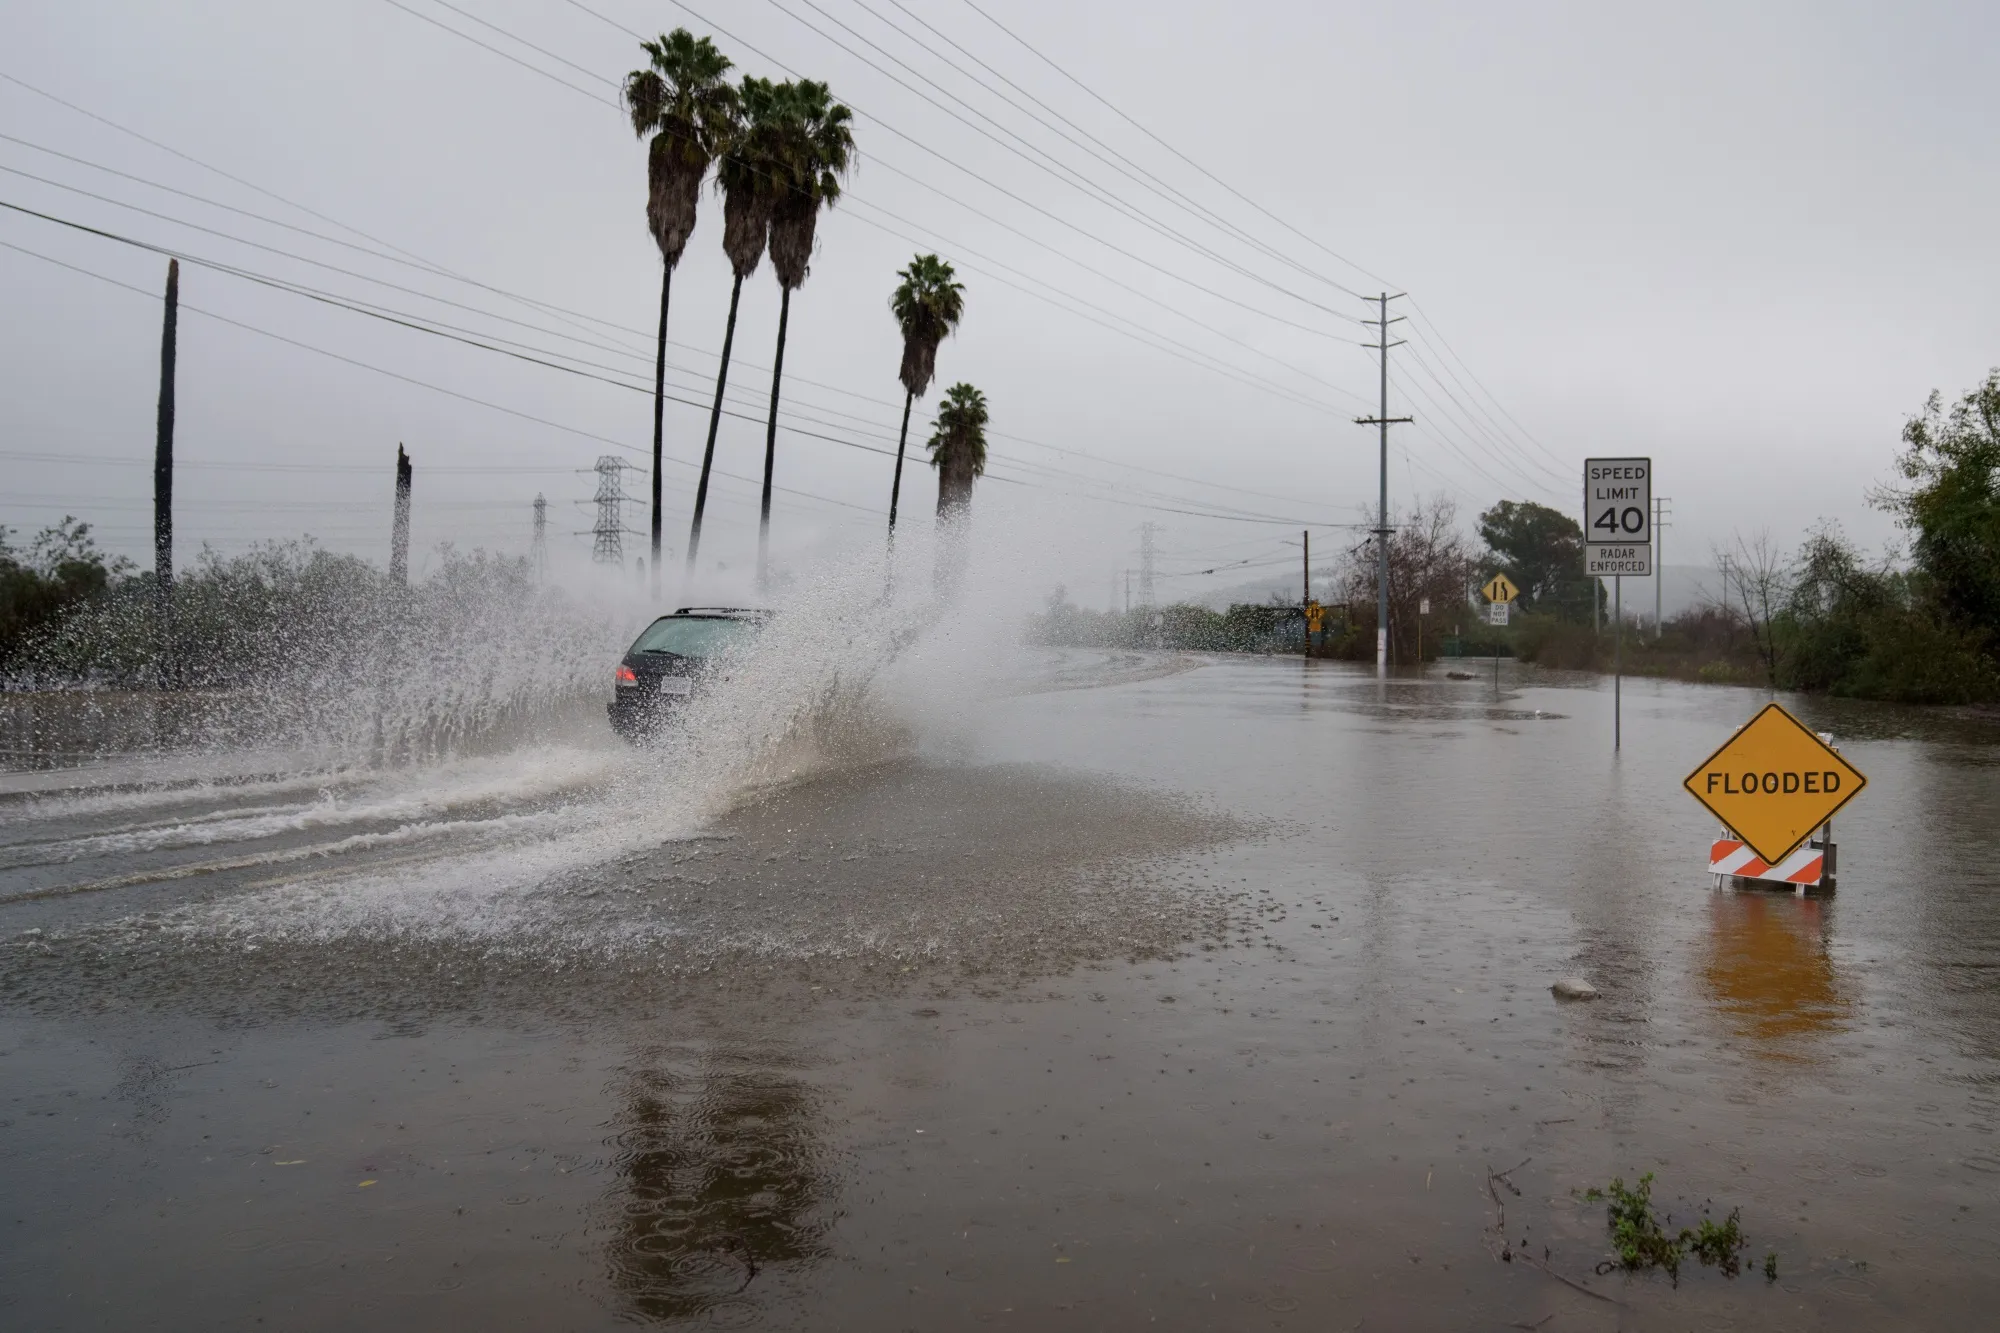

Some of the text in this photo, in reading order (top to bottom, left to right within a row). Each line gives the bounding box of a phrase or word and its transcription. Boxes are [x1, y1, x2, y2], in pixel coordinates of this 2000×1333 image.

[1591, 468, 1645, 479] SPEED
[1596, 487, 1639, 500] LIMIT
[1594, 506, 1644, 534] 40
[1600, 548, 1635, 558] RADAR
[1590, 561, 1645, 571] ENFORCED
[1707, 771, 1841, 794] FLOODED
